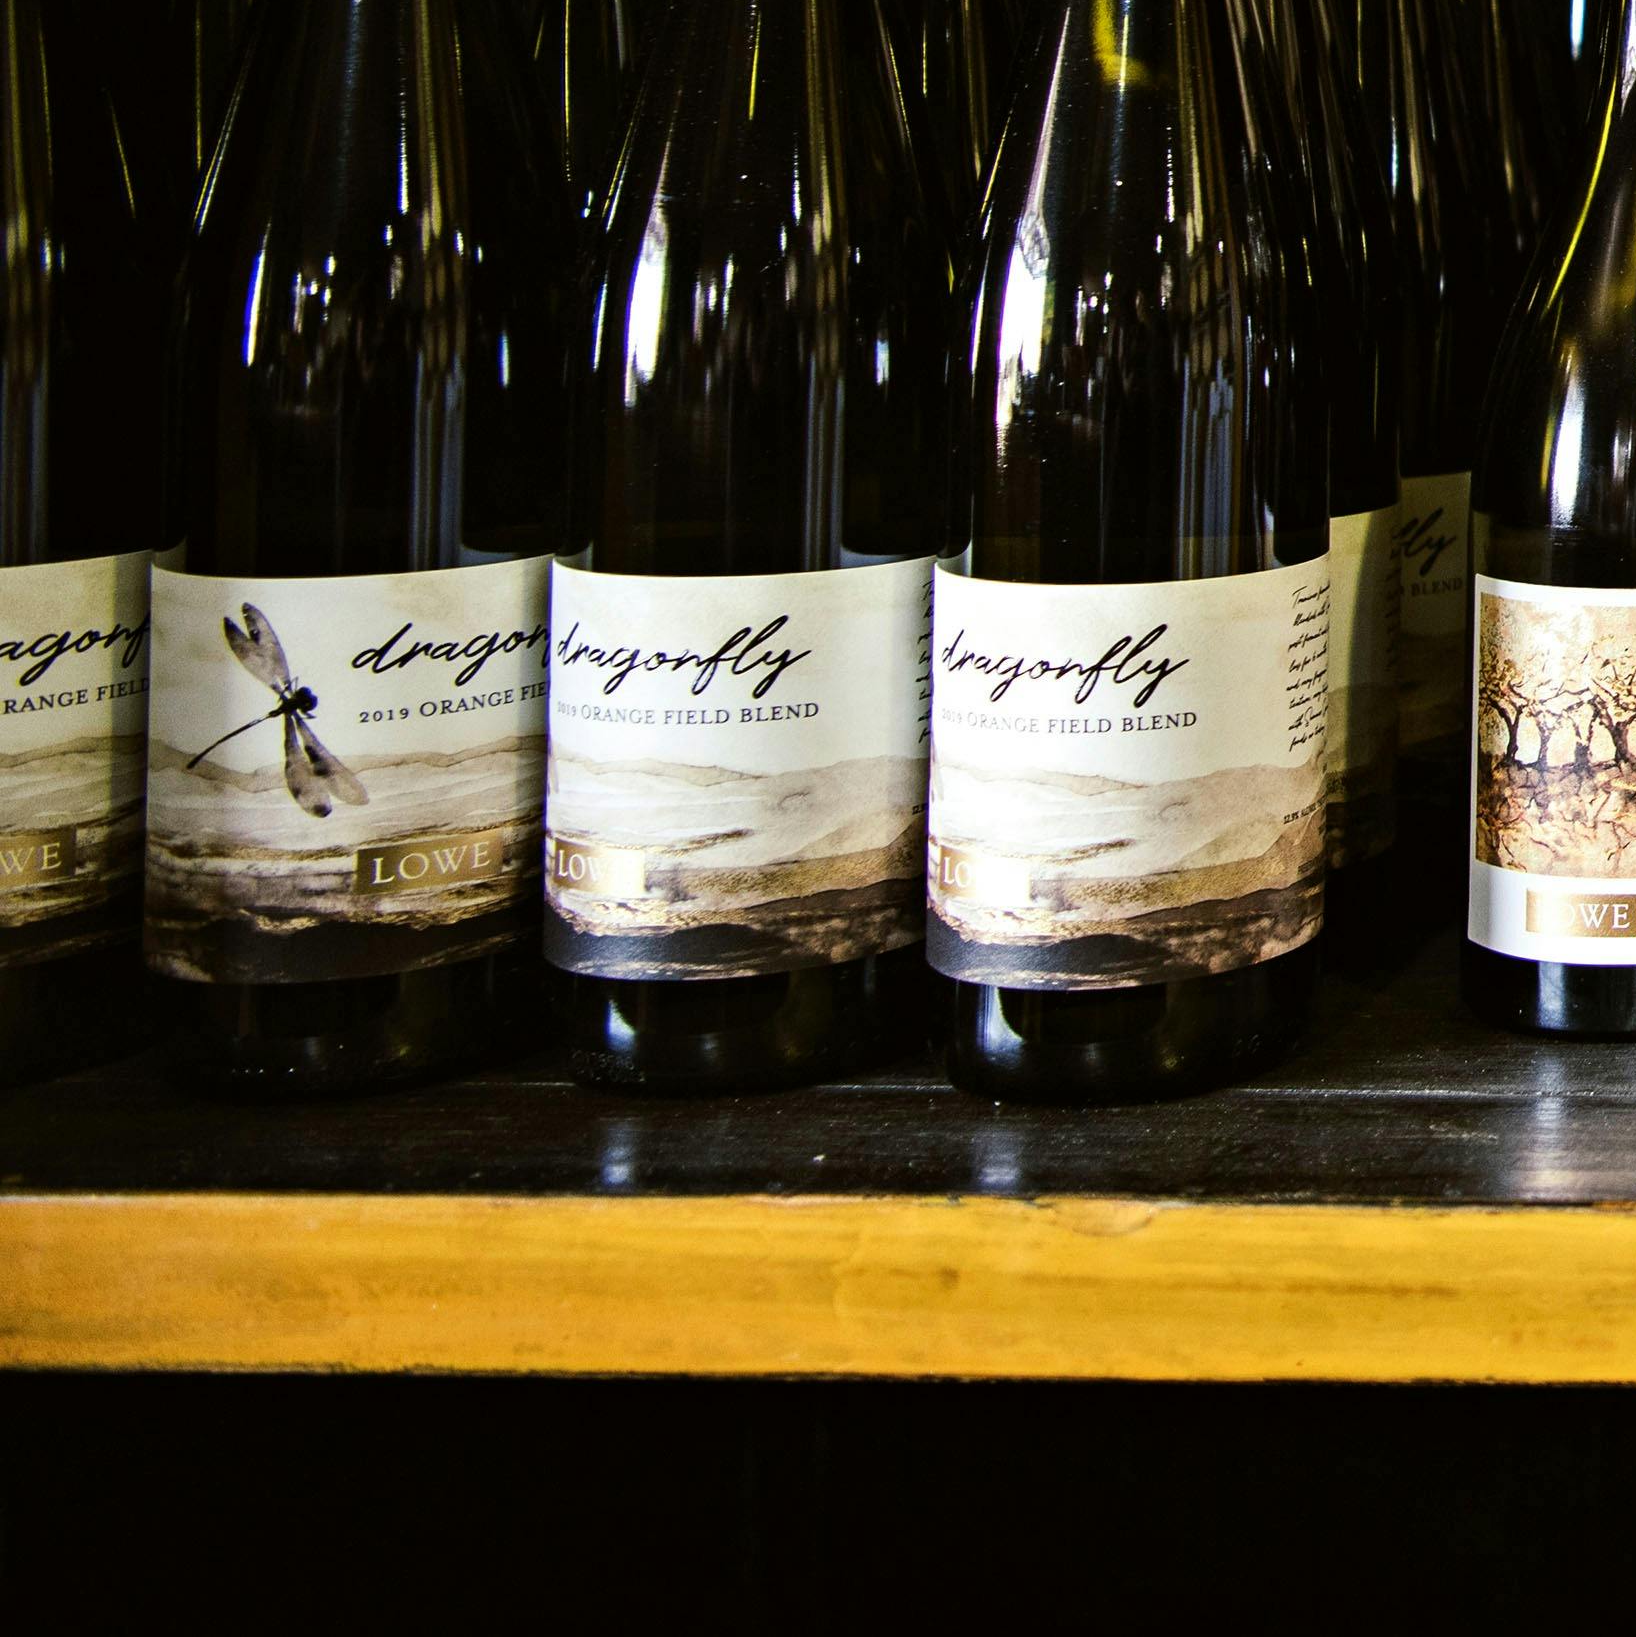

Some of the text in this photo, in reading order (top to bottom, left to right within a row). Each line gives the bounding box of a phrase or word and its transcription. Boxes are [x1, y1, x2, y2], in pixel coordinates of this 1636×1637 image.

[557, 615, 812, 699] dragonfly
[941, 624, 1191, 708] dragonfly
[359, 681, 549, 723] 2019 ORANGE FIE
[581, 704, 655, 724] ORANGE
[664, 709, 730, 725] FIELD
[740, 703, 819, 723] BLEND
[967, 711, 1040, 733] ORANGE
[1047, 719, 1112, 734] FIELD
[1122, 712, 1197, 732] BLEND
[372, 840, 491, 886] LOWE
